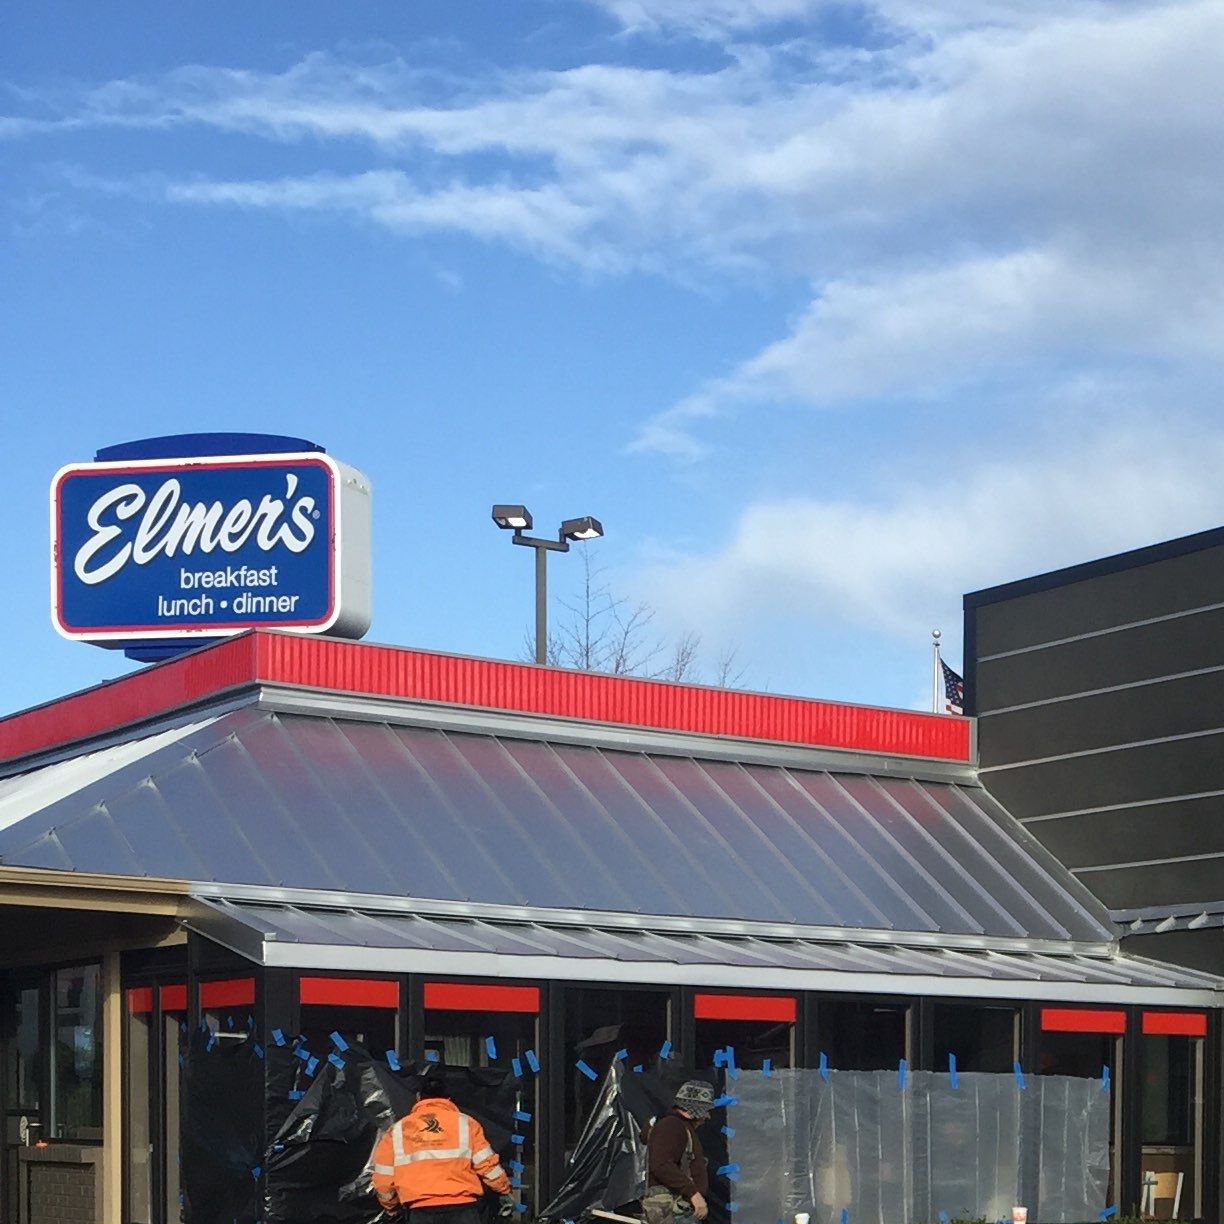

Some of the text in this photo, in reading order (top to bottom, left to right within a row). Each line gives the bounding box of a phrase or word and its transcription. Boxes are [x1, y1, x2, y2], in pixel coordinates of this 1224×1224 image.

[74, 473, 315, 585] Elmer's
[179, 565, 279, 589] breakfast
[157, 591, 300, 617] lunch dinner
